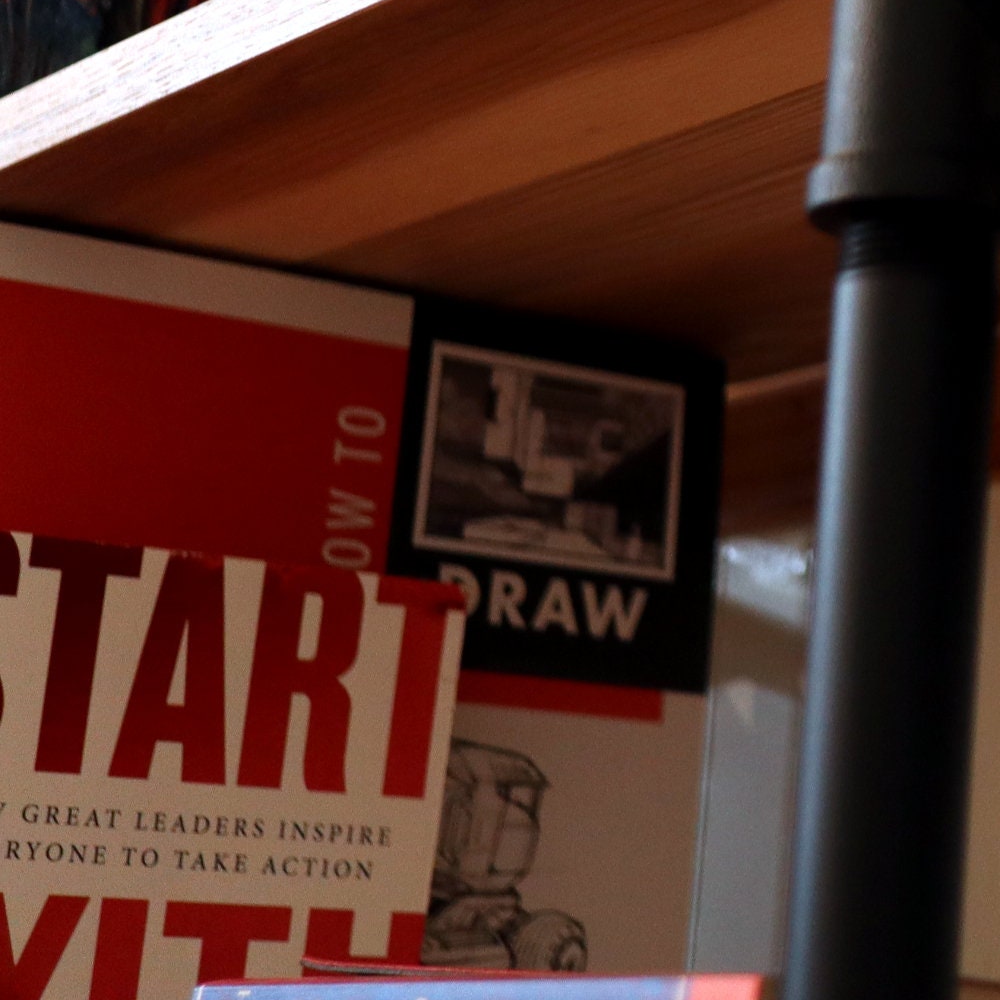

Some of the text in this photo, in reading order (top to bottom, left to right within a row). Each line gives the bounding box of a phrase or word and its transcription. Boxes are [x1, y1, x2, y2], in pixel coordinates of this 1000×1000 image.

[333, 404, 386, 464] TO
[438, 563, 645, 642] DRAW
[0, 531, 468, 800] TART
[21, 804, 393, 848] GREAT LEADERS INSPIRE
[122, 846, 160, 869] TO
[173, 849, 249, 874] TAKE
[262, 855, 374, 881] ACTION
